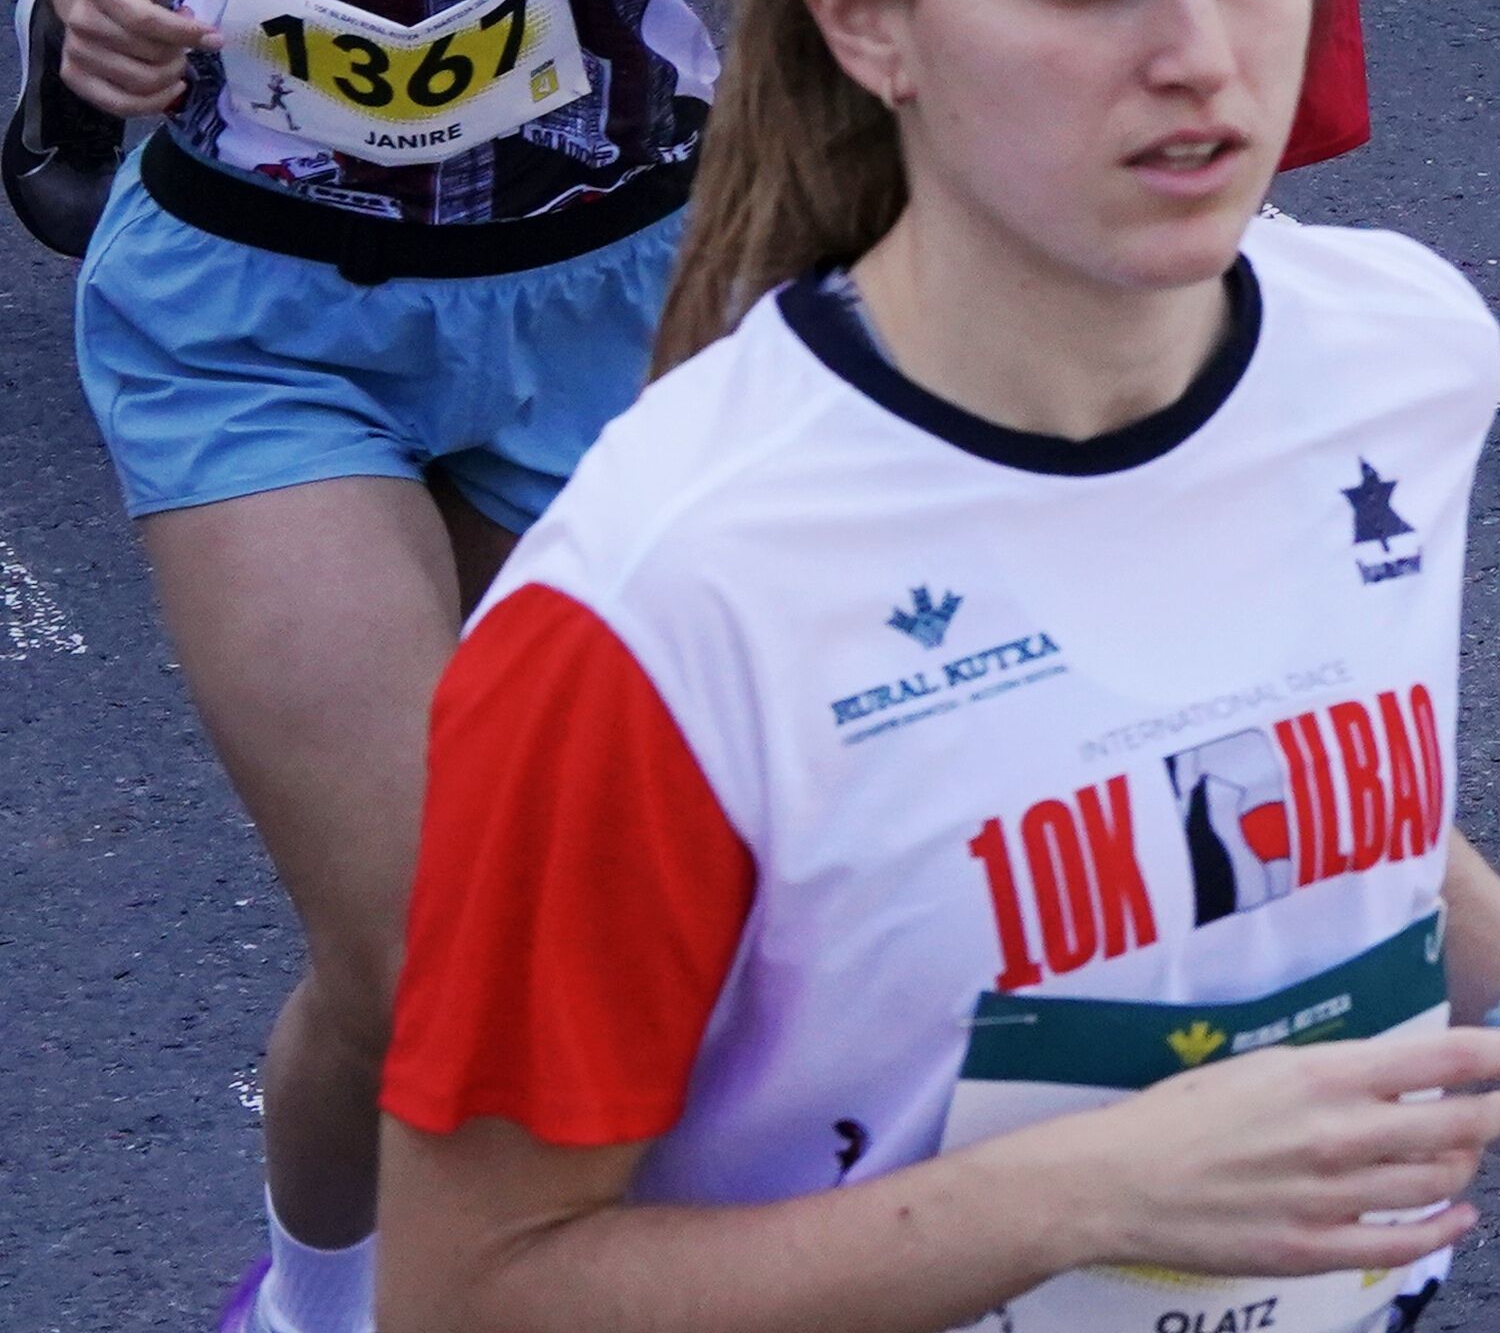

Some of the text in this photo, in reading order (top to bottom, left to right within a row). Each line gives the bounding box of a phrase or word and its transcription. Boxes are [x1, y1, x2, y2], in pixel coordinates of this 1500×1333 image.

[363, 122, 464, 151] JANIRE
[830, 633, 1063, 729] RURAL KUTXA
